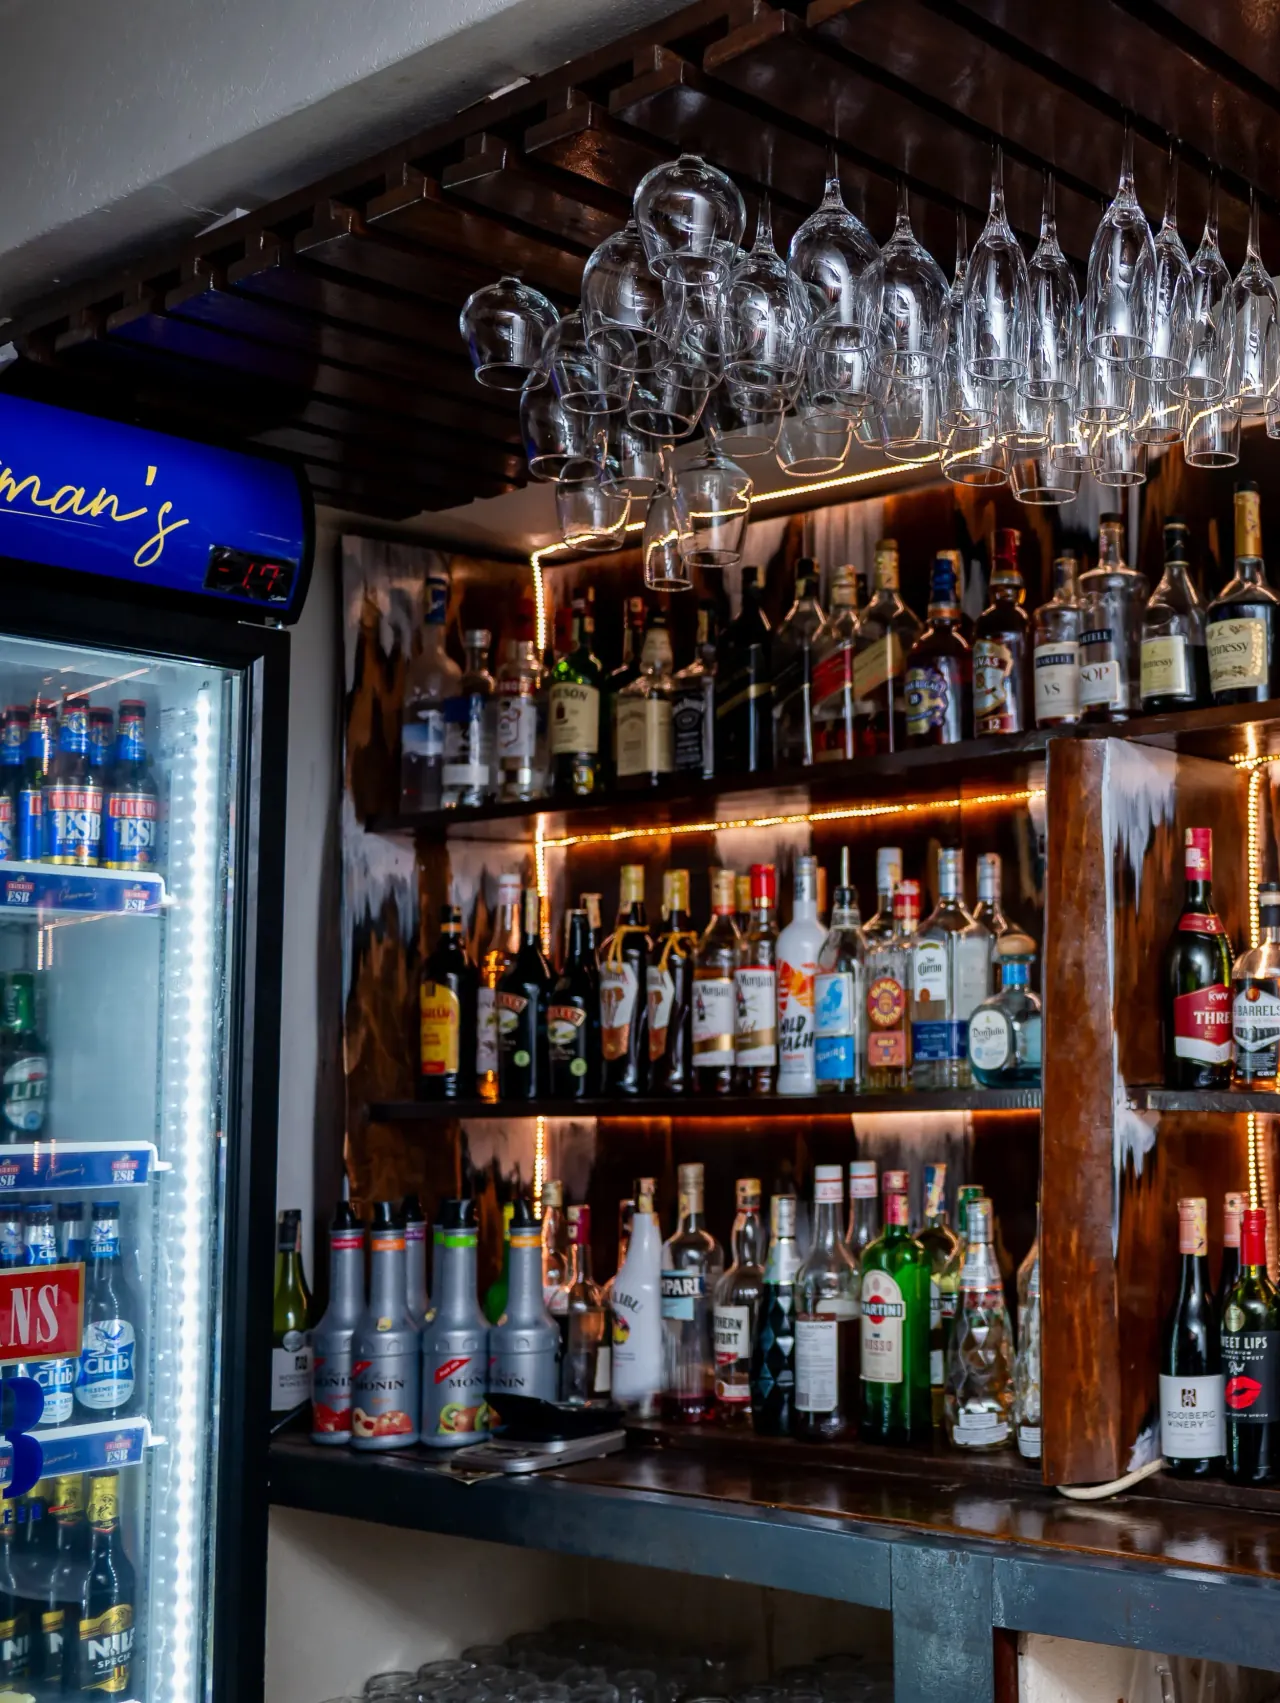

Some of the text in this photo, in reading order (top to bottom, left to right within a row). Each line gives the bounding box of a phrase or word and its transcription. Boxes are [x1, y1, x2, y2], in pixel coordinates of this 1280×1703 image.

[1209, 642, 1250, 657] ennessy
[1080, 667, 1110, 682] SOP
[1045, 682, 1060, 696] VS
[57, 811, 101, 840] ESB
[7, 891, 30, 903] ESB
[124, 898, 146, 911] ESB
[1206, 918, 1217, 932] 3
[1208, 991, 1229, 1002] KWV
[113, 1170, 136, 1183] ESB
[91, 1243, 114, 1254] Club
[0, 1284, 59, 1348] NS
[1243, 1335, 1269, 1350] LIPS
[84, 1356, 131, 1376] Club
[34, 1367, 74, 1388] Club
[106, 1449, 129, 1463] ESB
